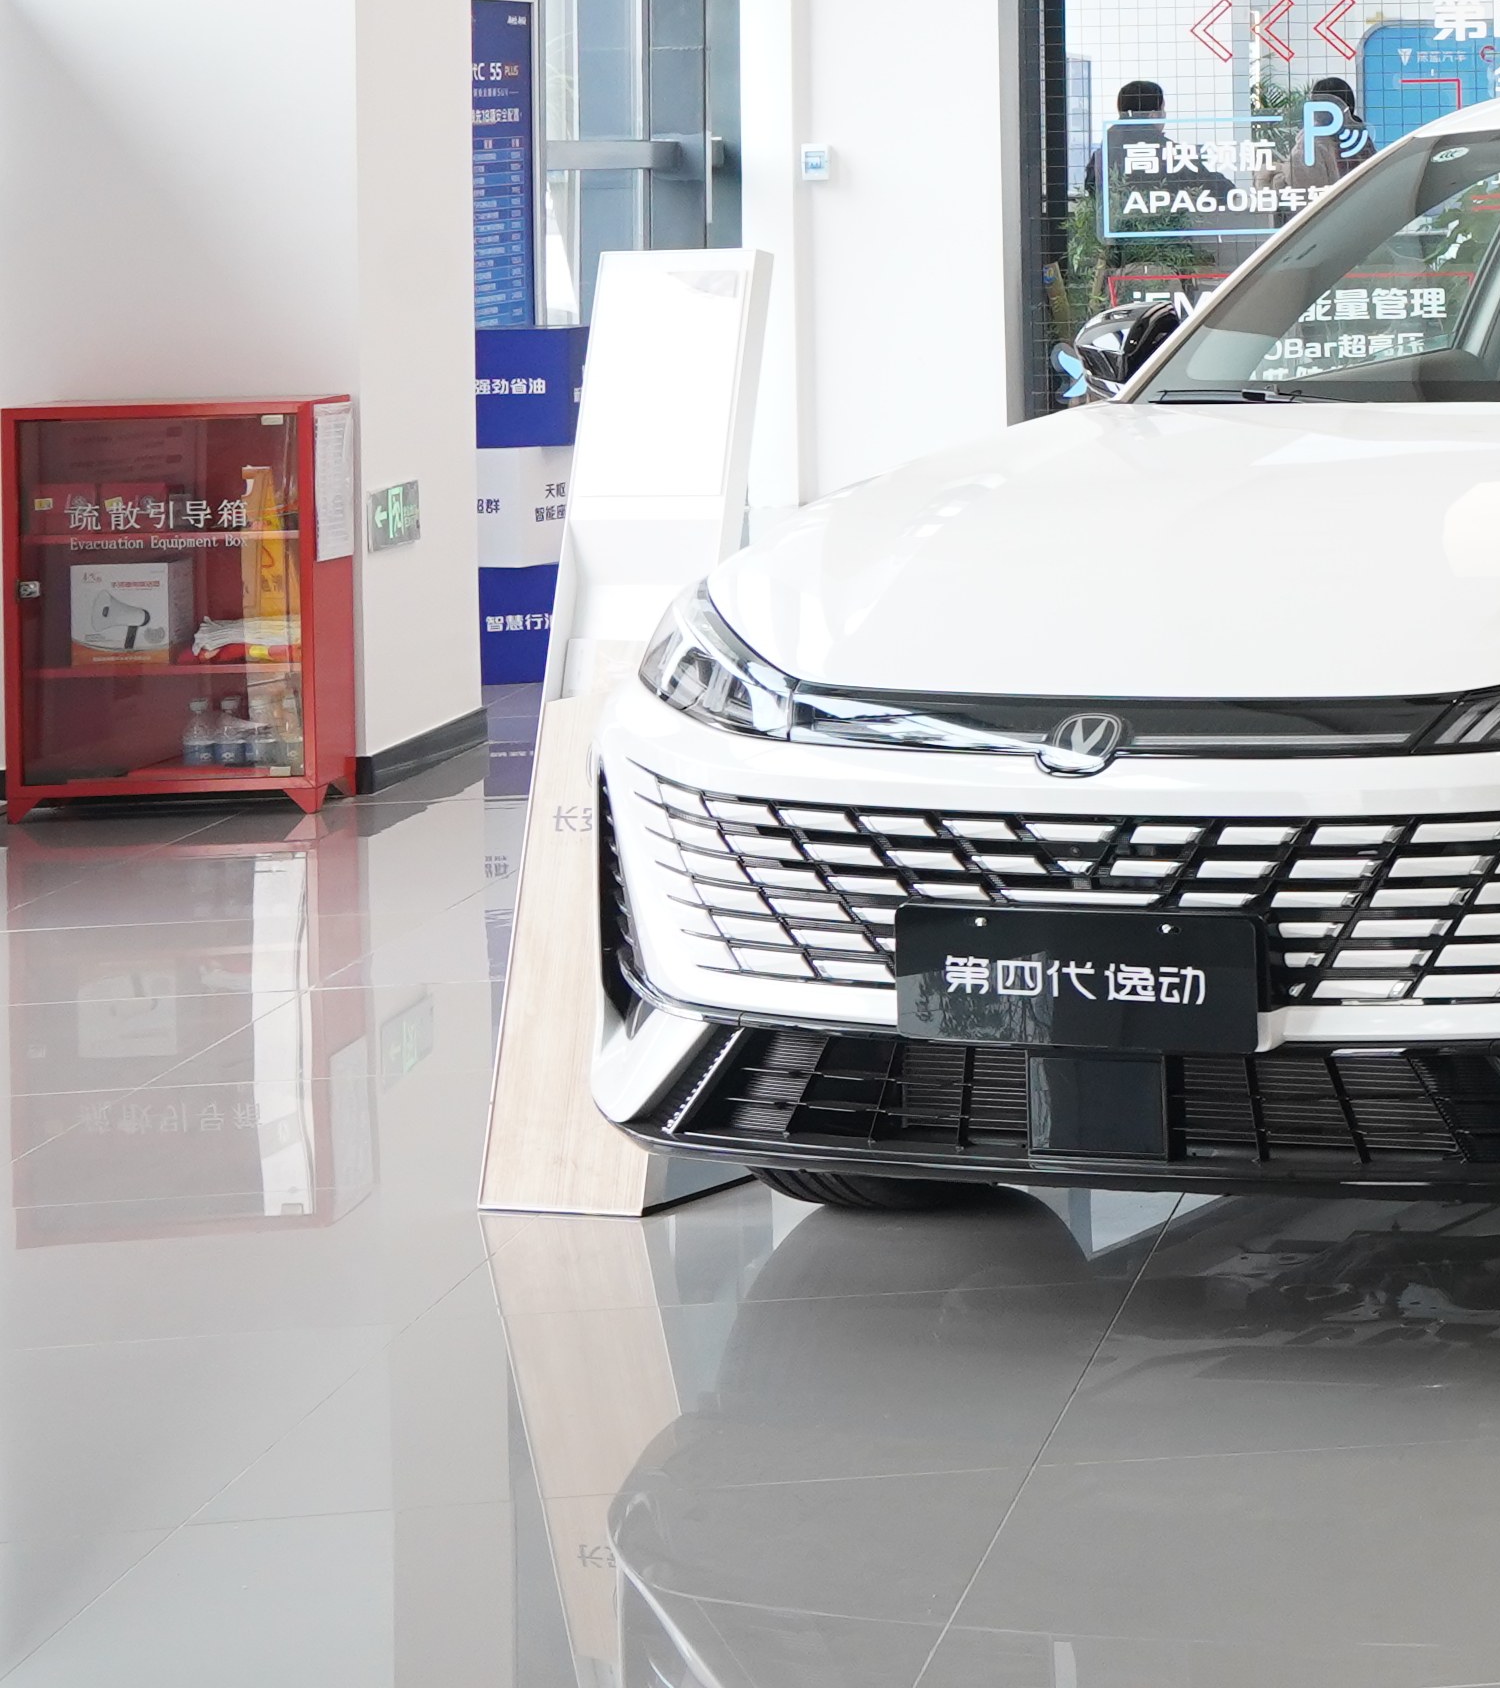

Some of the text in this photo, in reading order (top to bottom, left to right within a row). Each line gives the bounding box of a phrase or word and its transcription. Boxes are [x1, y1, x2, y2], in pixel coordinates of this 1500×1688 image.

[1122, 140, 1277, 175] 高快领航
[69, 499, 248, 531] 疏散引导箱
[70, 534, 248, 551] Evacuation Equipment Box
[944, 954, 1206, 1006] 第四代逸动
